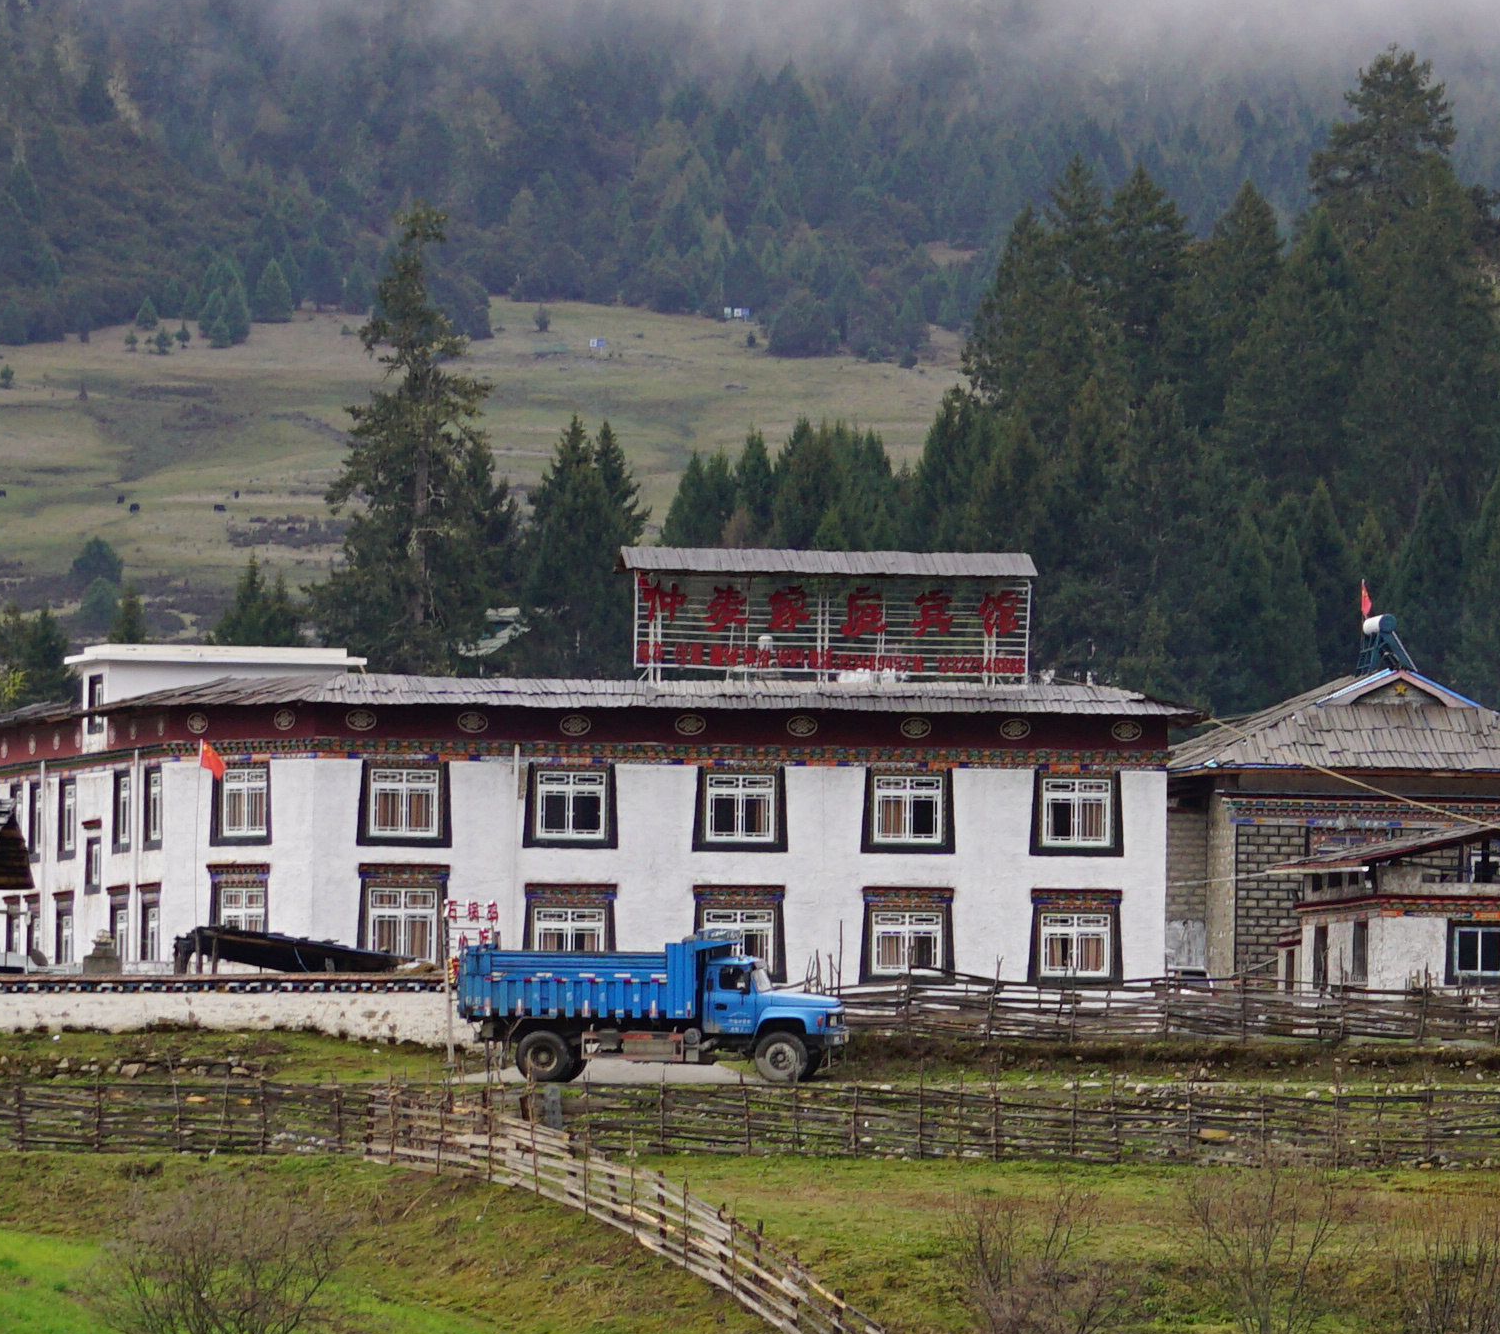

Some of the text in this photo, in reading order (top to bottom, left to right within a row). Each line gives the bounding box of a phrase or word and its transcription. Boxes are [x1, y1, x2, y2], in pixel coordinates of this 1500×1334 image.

[642, 579, 1021, 638] 仲麦家庭宾馆
